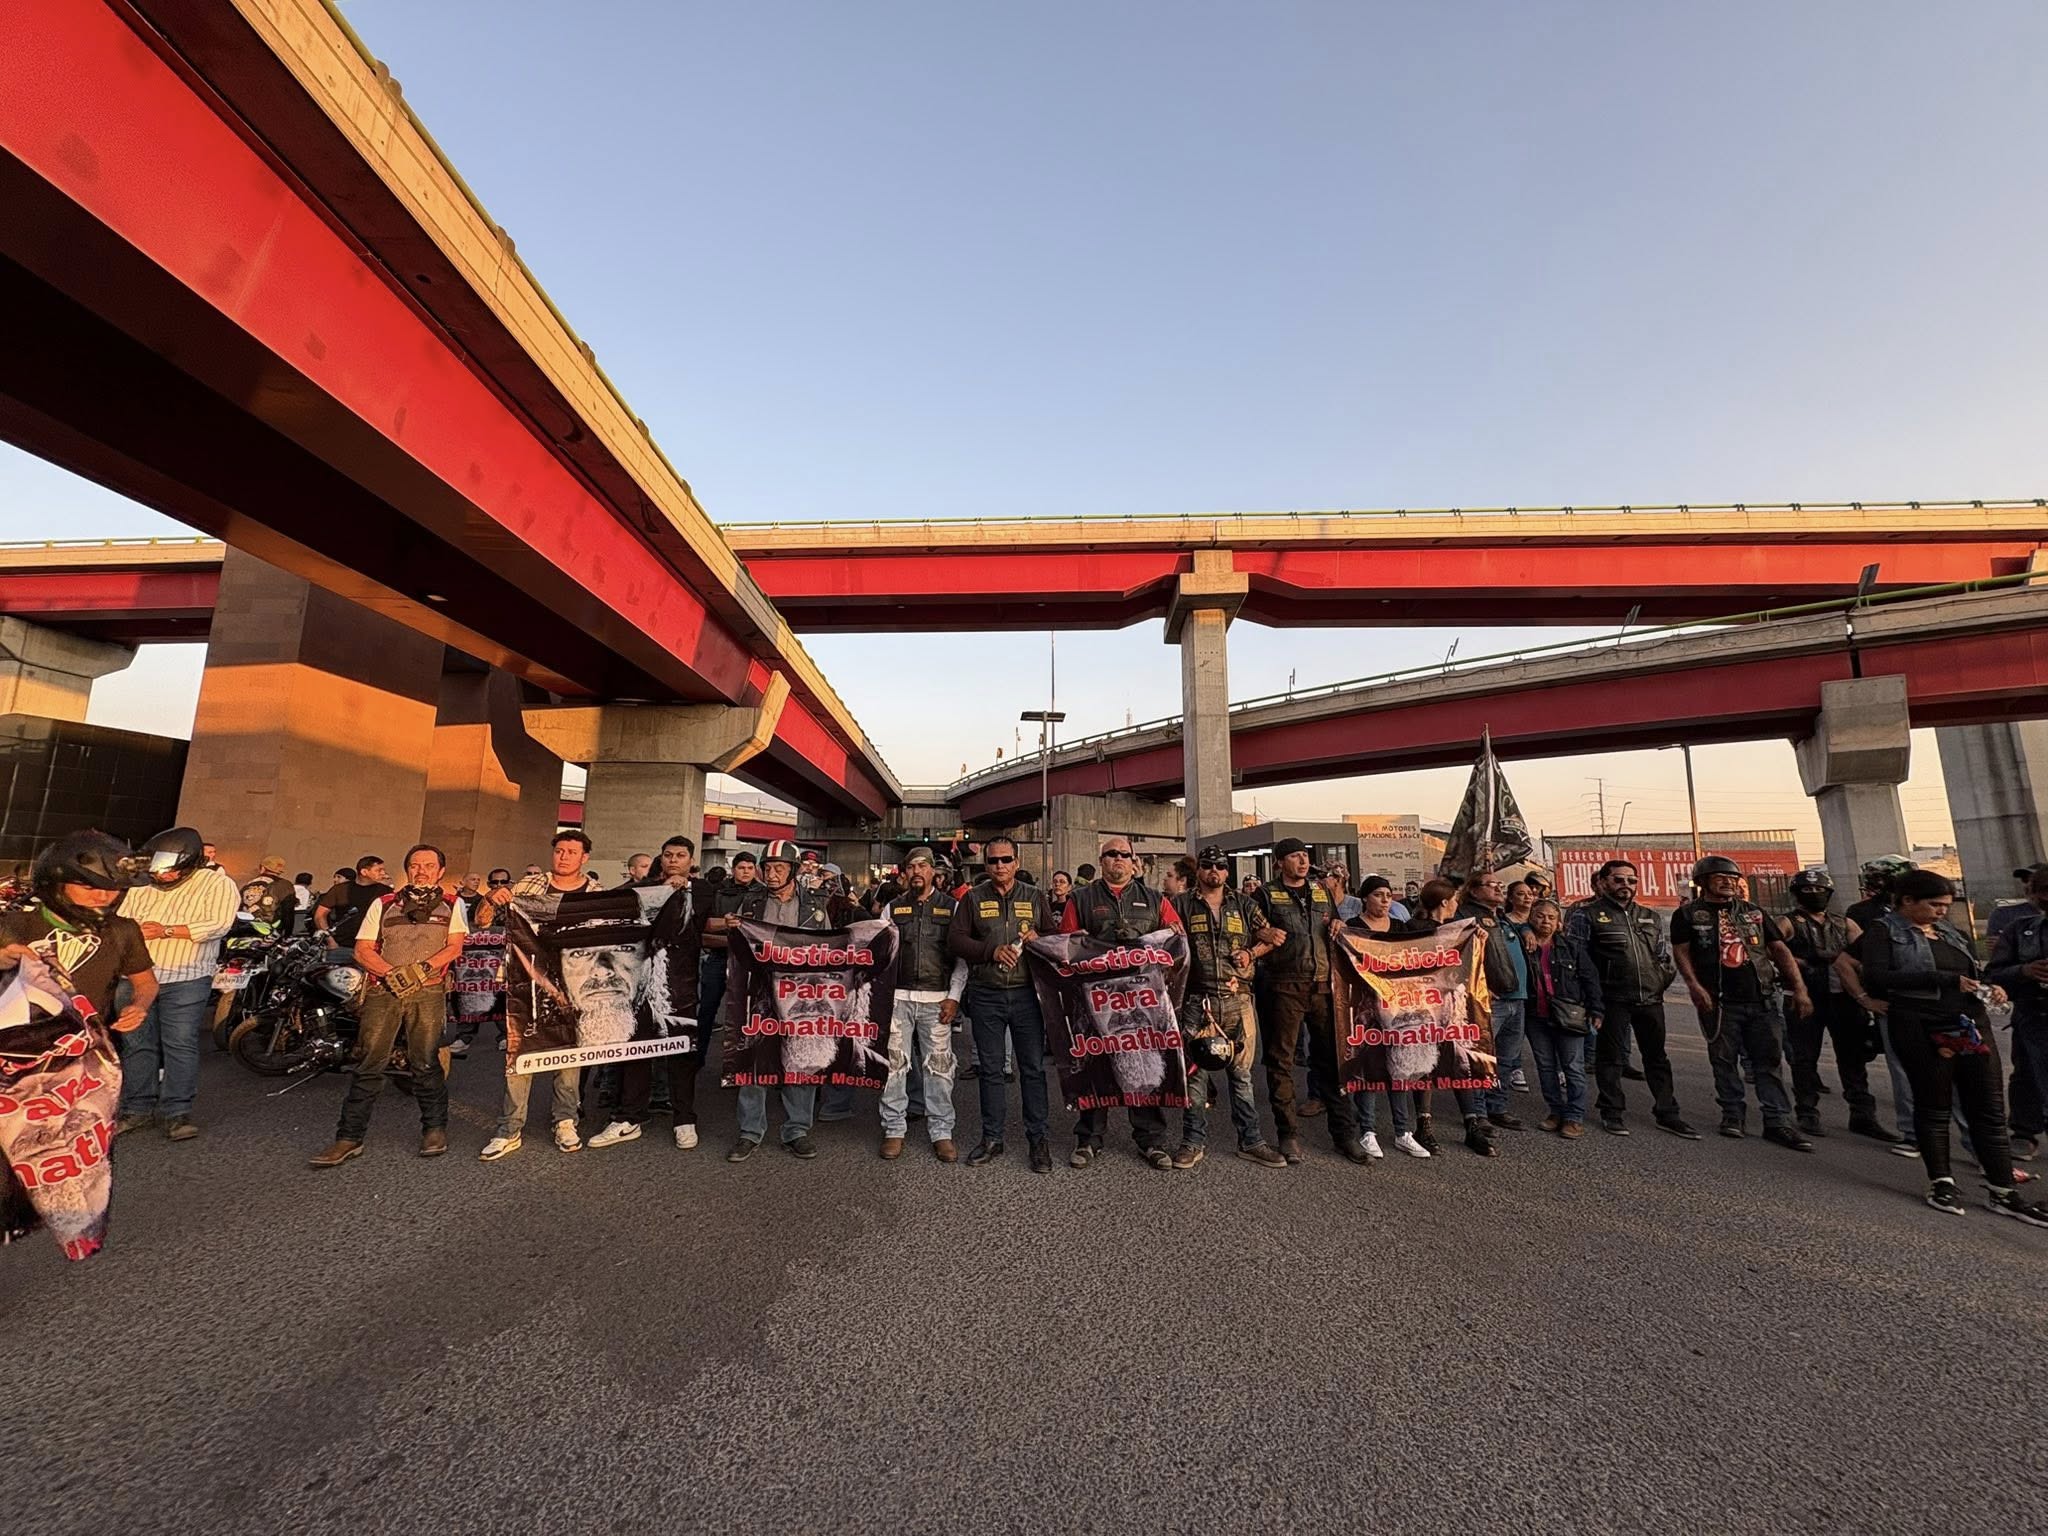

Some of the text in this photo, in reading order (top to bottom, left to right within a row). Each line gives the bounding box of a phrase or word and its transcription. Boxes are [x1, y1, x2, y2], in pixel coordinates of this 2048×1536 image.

[1562, 852, 1610, 861] DERECHO
[1623, 852, 1631, 861] A
[1640, 852, 1653, 861] LA
[1640, 863, 1660, 896] LA
[456, 956, 502, 969] Para
[754, 940, 874, 966] Justicia
[1057, 945, 1175, 977] Justicia
[1356, 945, 1462, 973] Justicia
[778, 979, 846, 1000] Para
[1091, 987, 1159, 1013] Para
[742, 1014, 879, 1040] Jonathan
[1347, 1022, 1481, 1046] Jonathan
[535, 1055, 577, 1067] TODOS
[579, 1049, 622, 1062] SOMOS
[624, 1040, 685, 1057] JONATHAN
[1069, 1026, 1184, 1057] Jonatha
[735, 1071, 881, 1089] Ni un Biker Menos
[1437, 1076, 1493, 1090] Menos
[1100, 1093, 1120, 1105] un
